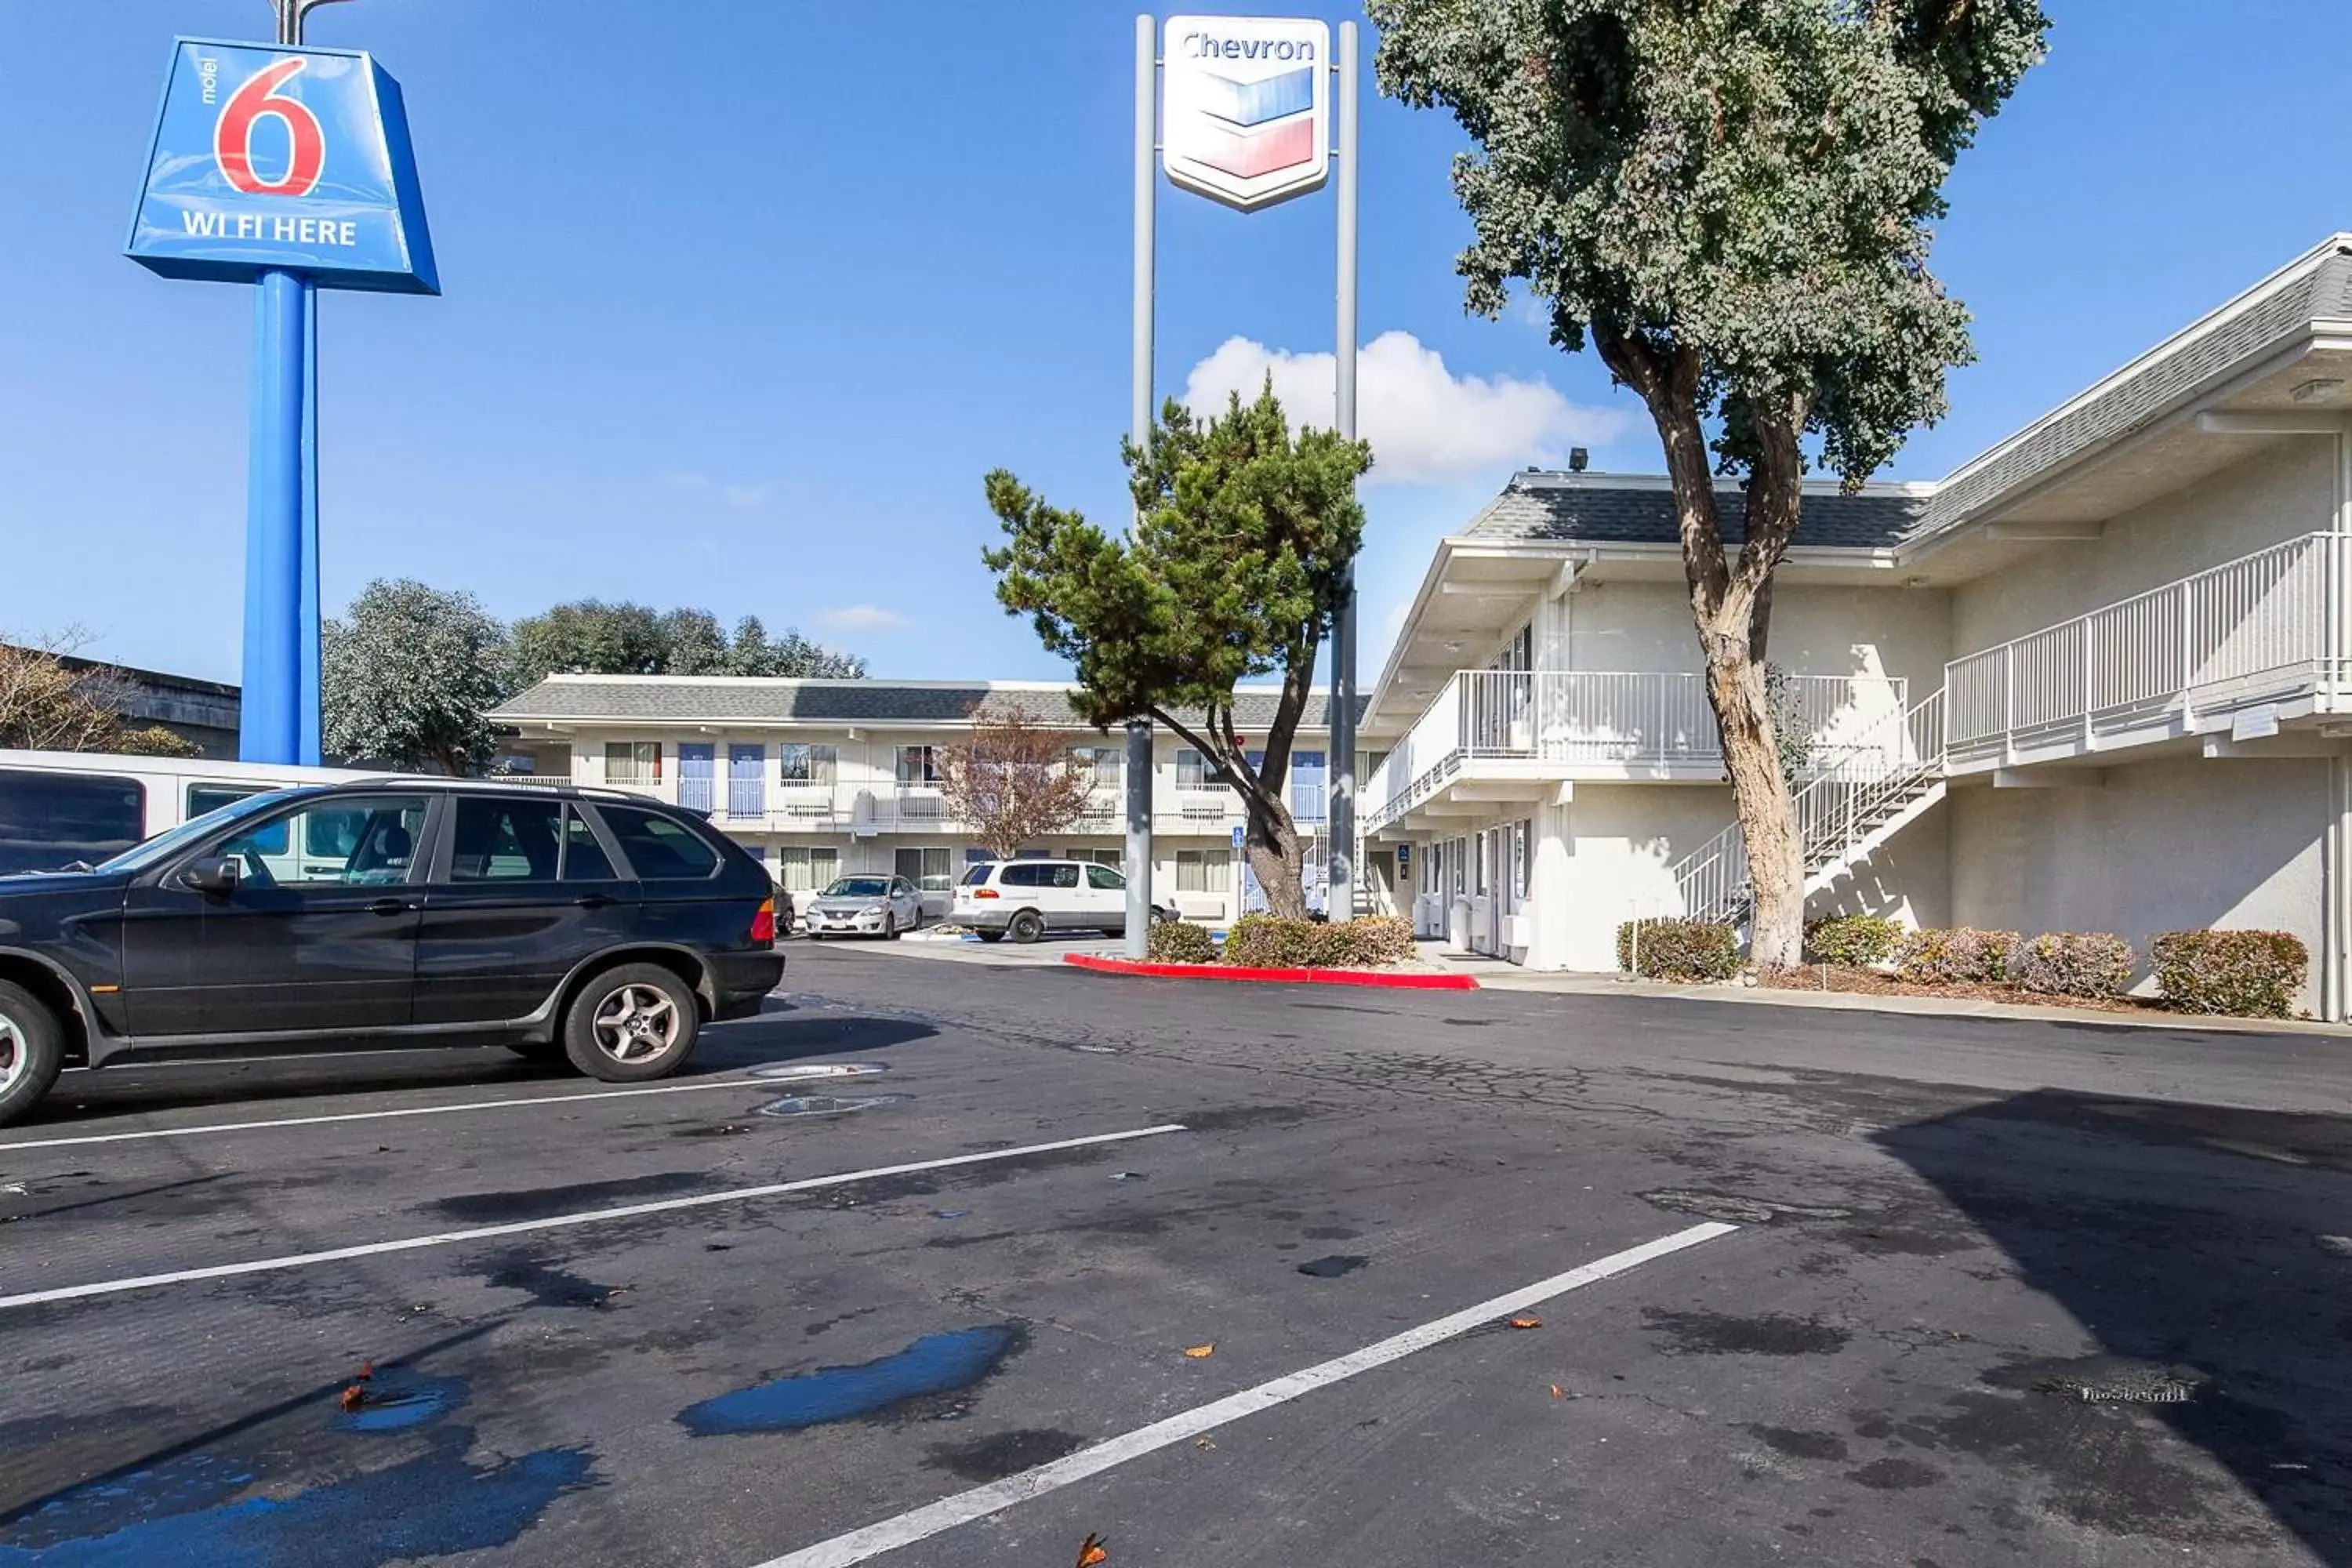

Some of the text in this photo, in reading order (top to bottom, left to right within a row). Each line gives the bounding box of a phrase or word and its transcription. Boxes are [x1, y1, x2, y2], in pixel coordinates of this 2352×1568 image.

[1181, 32, 1315, 60] Chevron
[199, 56, 326, 197] motel 6
[182, 210, 357, 246] WI FI HERE
